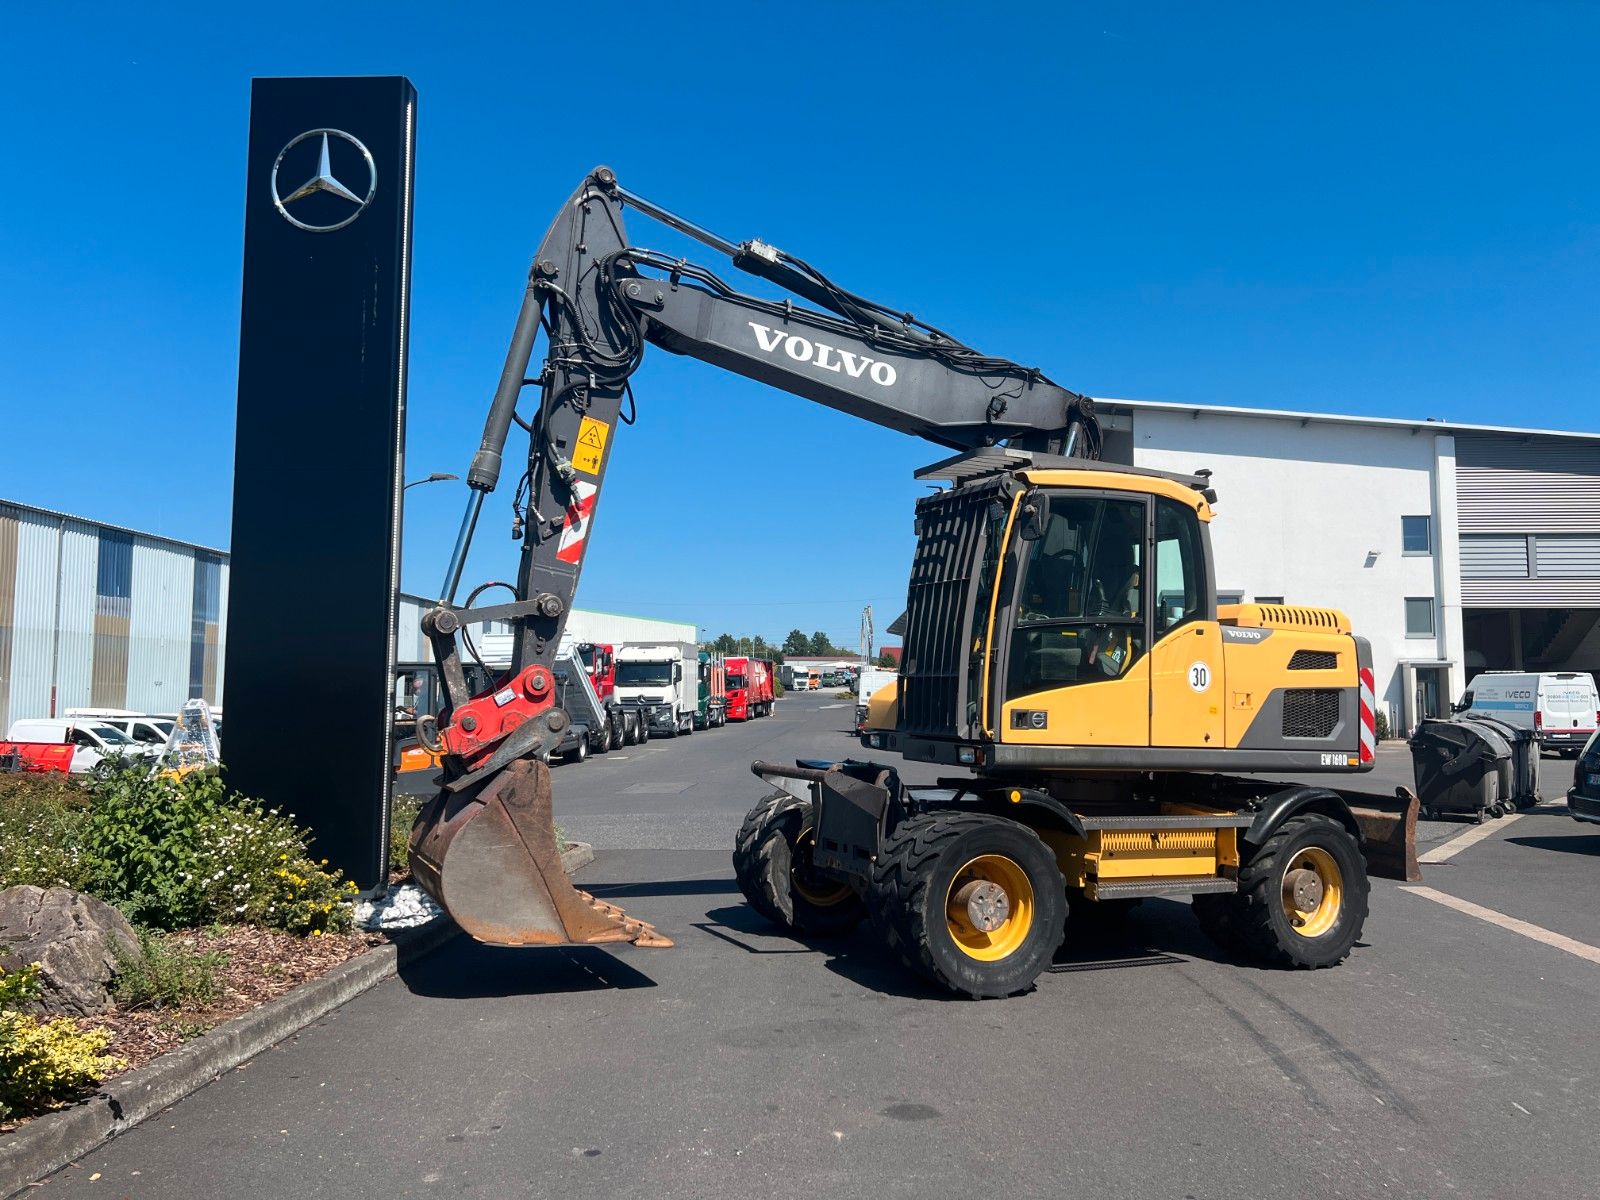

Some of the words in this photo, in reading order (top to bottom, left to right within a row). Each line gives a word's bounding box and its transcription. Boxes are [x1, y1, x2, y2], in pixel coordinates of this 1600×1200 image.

[748, 322, 897, 386] VOLVO
[1227, 630, 1261, 639] VOLVO
[1193, 668, 1206, 686] 30
[1505, 690, 1531, 698] IVECO
